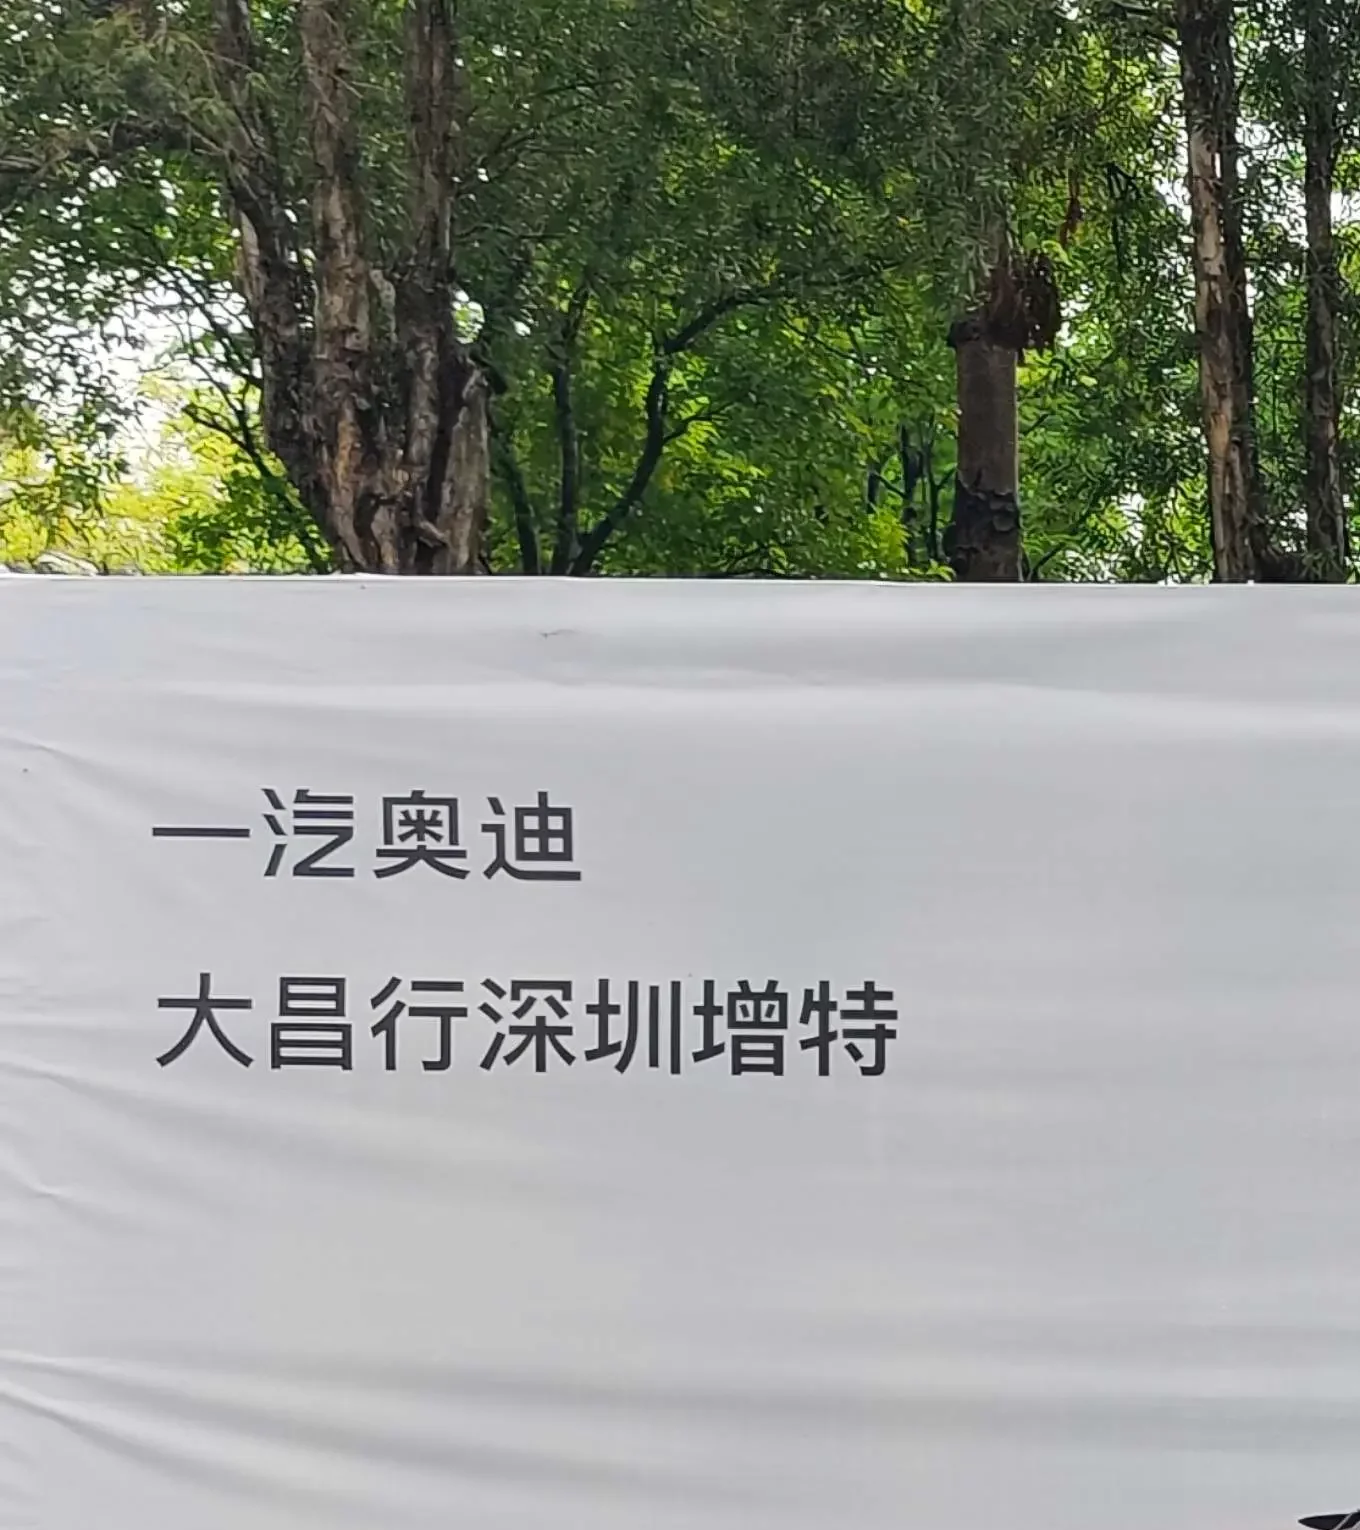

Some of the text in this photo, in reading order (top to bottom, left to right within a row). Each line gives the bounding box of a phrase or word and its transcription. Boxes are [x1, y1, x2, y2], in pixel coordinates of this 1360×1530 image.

[152, 788, 582, 881] 一汽奥迪
[155, 972, 899, 1077] 大昌行深圳增特
